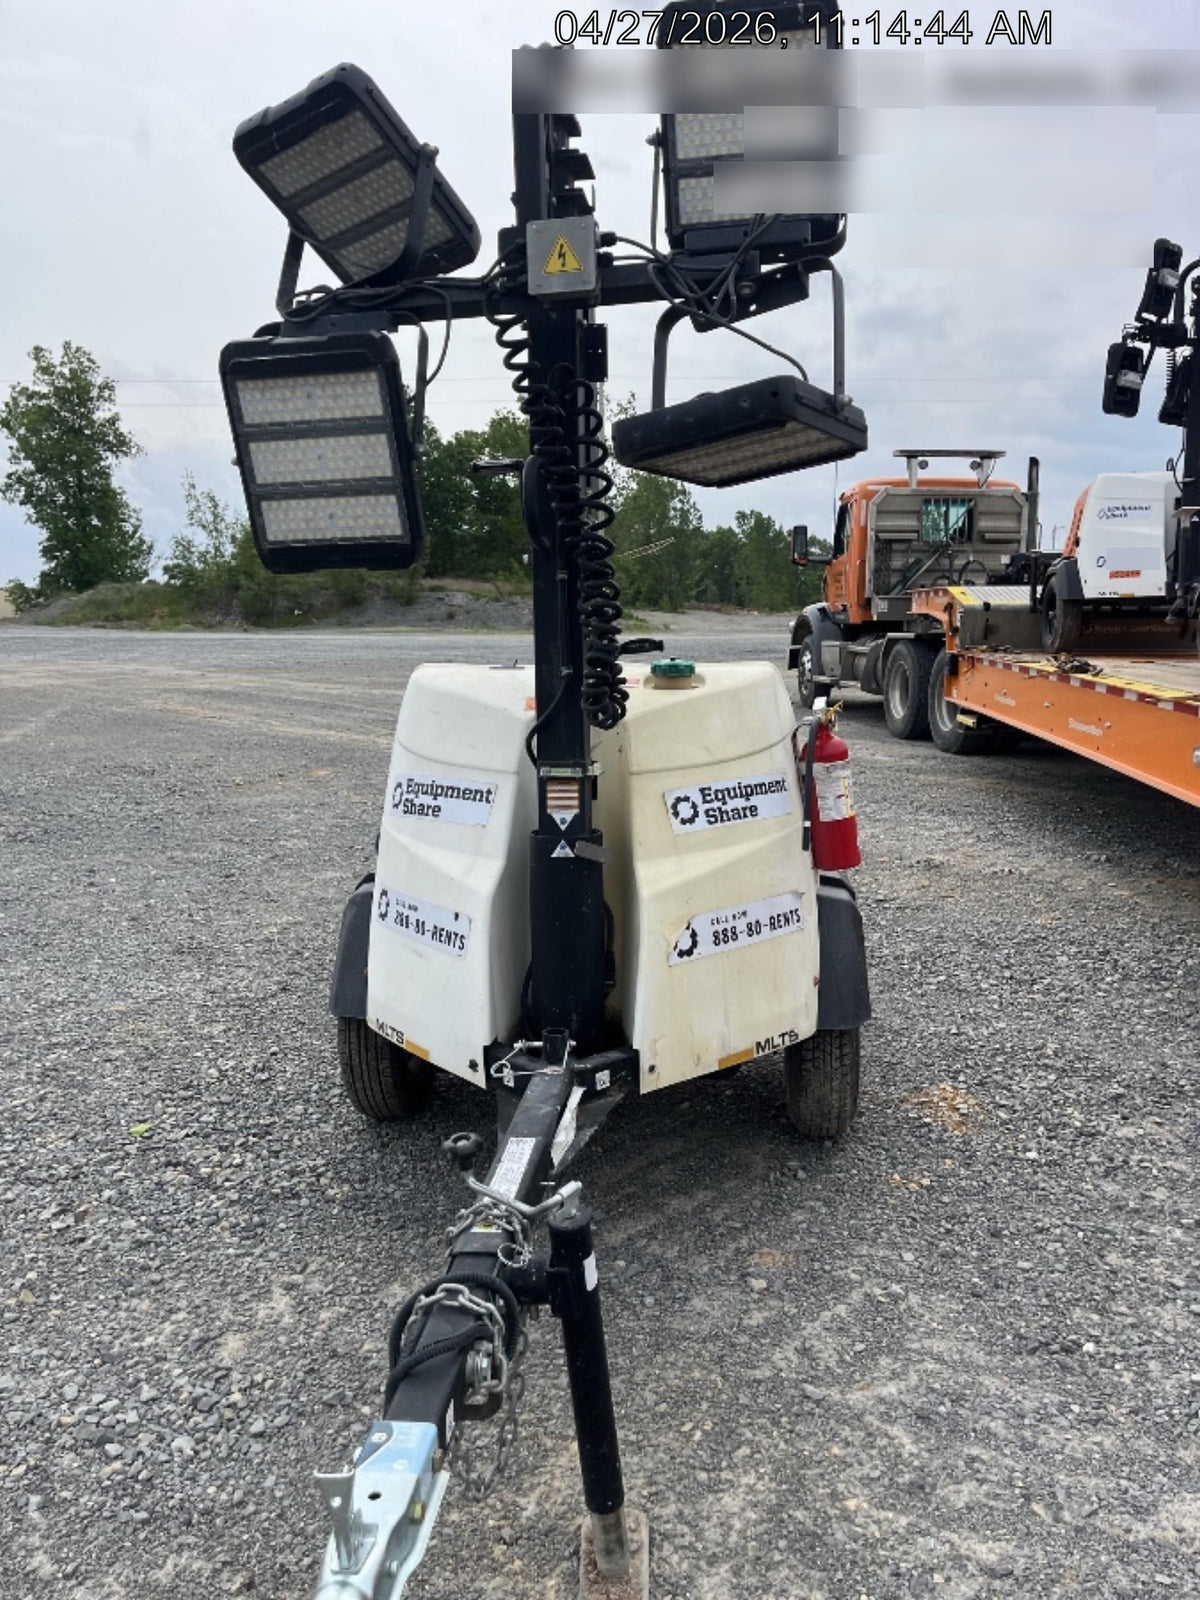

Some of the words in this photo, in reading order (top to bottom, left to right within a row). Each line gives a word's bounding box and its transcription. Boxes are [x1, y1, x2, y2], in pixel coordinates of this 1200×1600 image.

[405, 778, 493, 804] Equipment
[699, 777, 788, 806] Equipment
[403, 798, 441, 818] Share
[704, 804, 759, 825] Share
[712, 908, 801, 947] 888-80-RENTS
